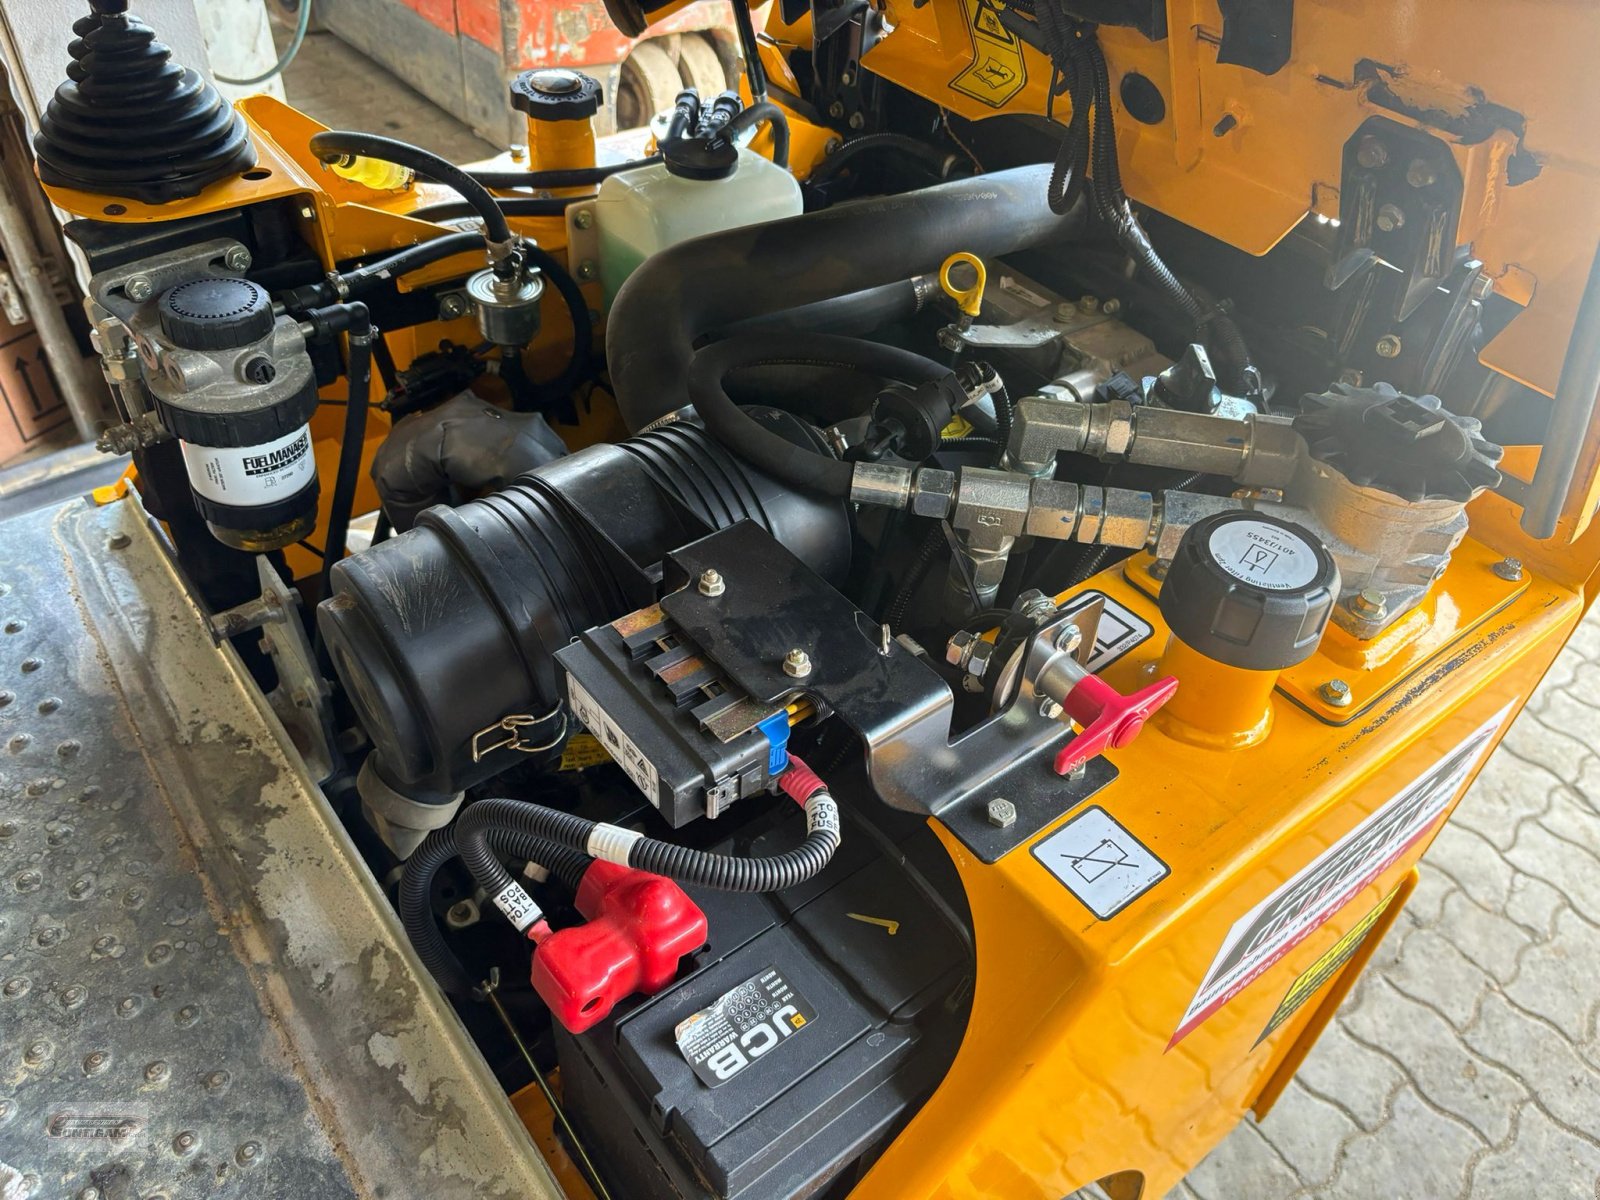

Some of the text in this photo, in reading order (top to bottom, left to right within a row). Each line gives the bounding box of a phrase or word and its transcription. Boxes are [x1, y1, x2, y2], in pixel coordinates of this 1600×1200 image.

[499, 884, 521, 904] POS
[1188, 931, 1290, 1017] Baumaschinen
[781, 992, 794, 1003] YEAR
[694, 1031, 738, 1065] WARRANTY
[707, 1004, 807, 1080] JCB
